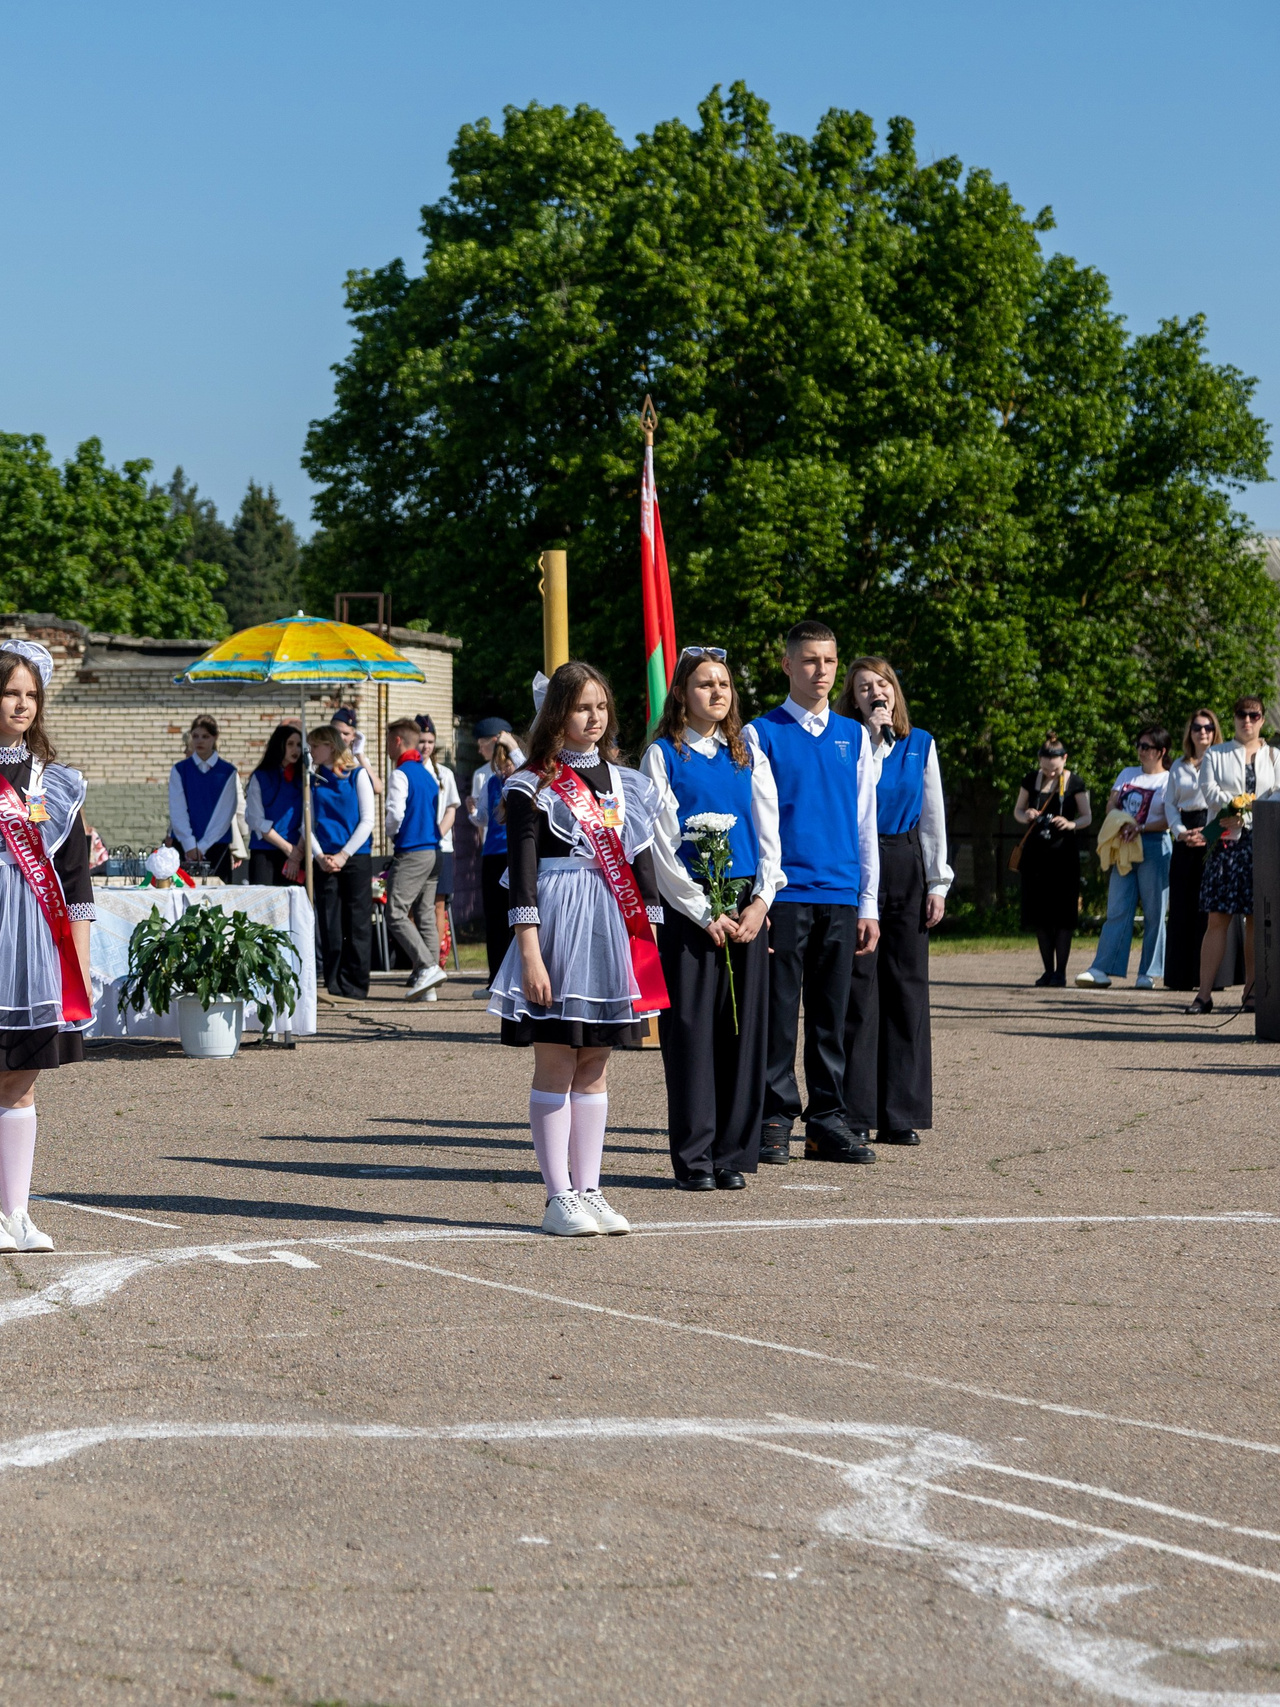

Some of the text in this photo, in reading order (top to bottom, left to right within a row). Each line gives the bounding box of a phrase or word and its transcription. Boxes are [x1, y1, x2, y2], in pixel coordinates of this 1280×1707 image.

[559, 778, 621, 881] Выпускница
[614, 879, 642, 919] 2023
[37, 880, 65, 921] 2023
